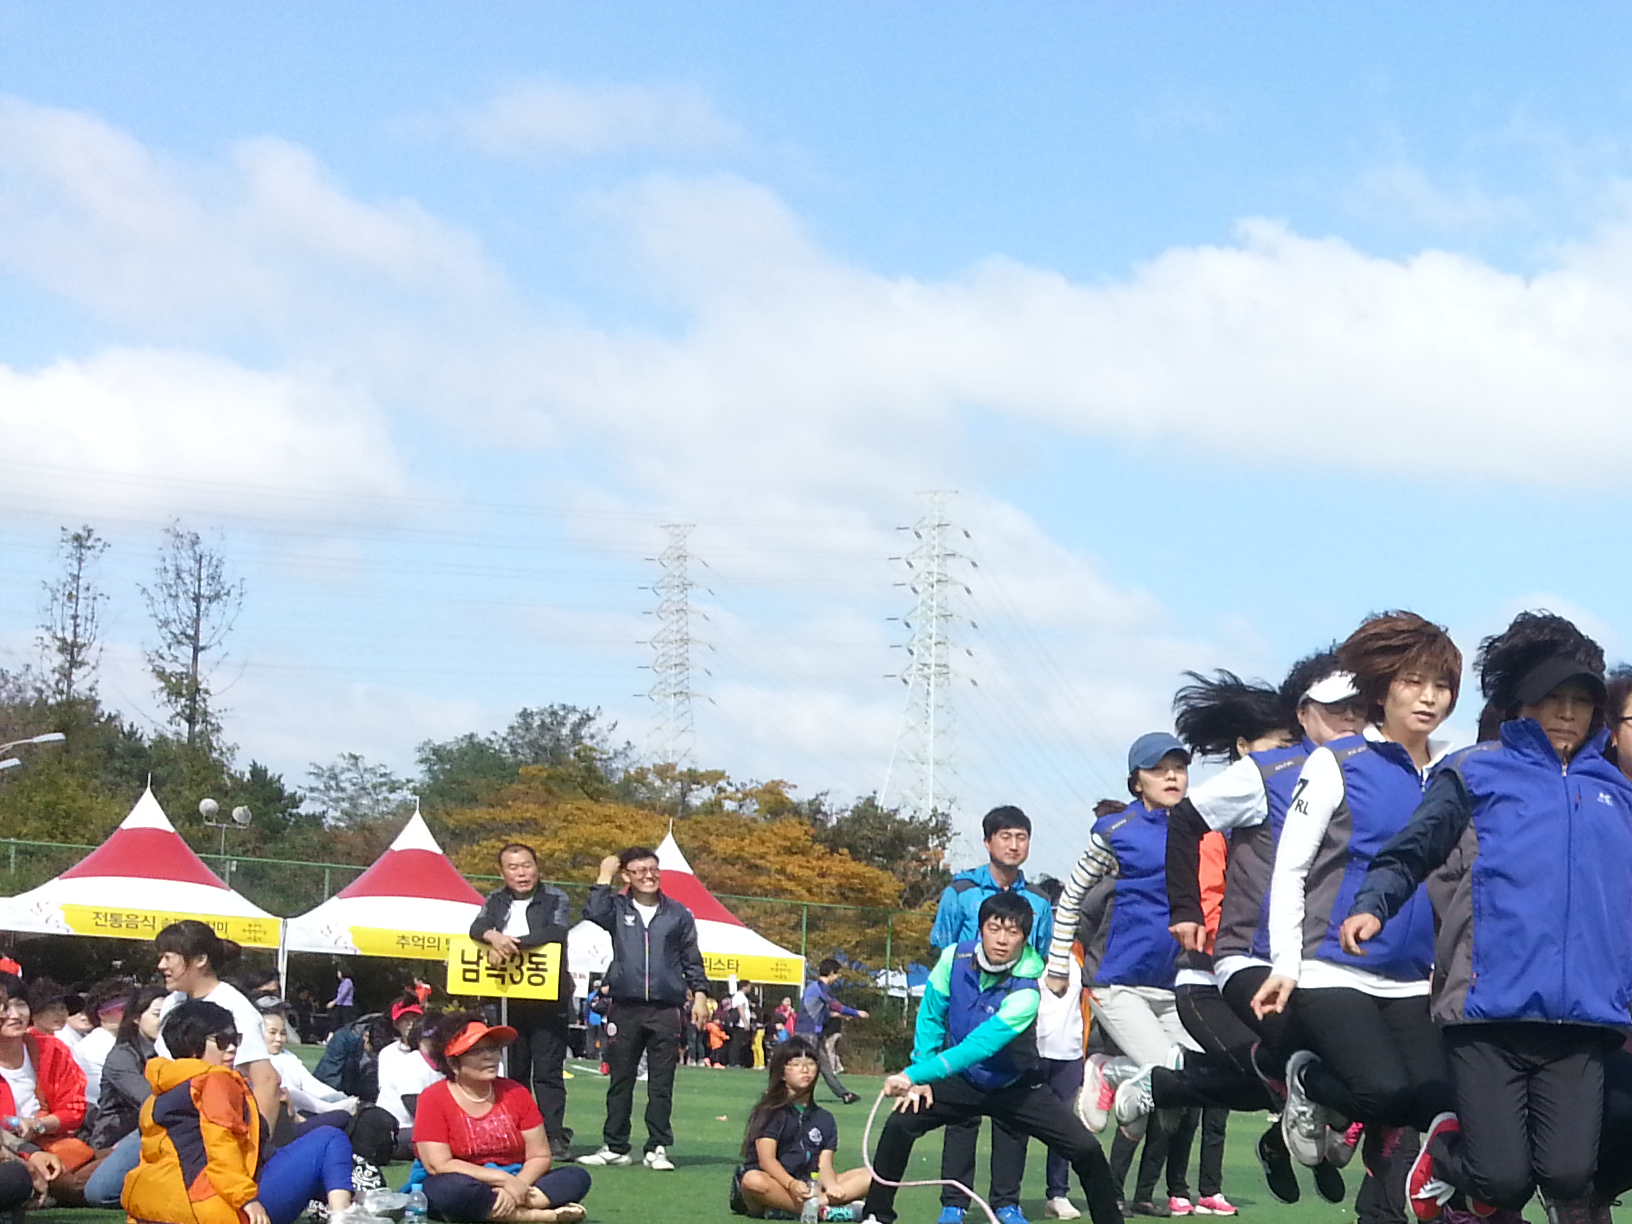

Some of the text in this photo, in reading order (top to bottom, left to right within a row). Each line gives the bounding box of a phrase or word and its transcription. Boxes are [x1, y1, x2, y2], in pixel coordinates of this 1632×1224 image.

[1294, 799, 1309, 817] RL
[93, 911, 156, 930] 전통음식
[396, 934, 441, 951] 추억의
